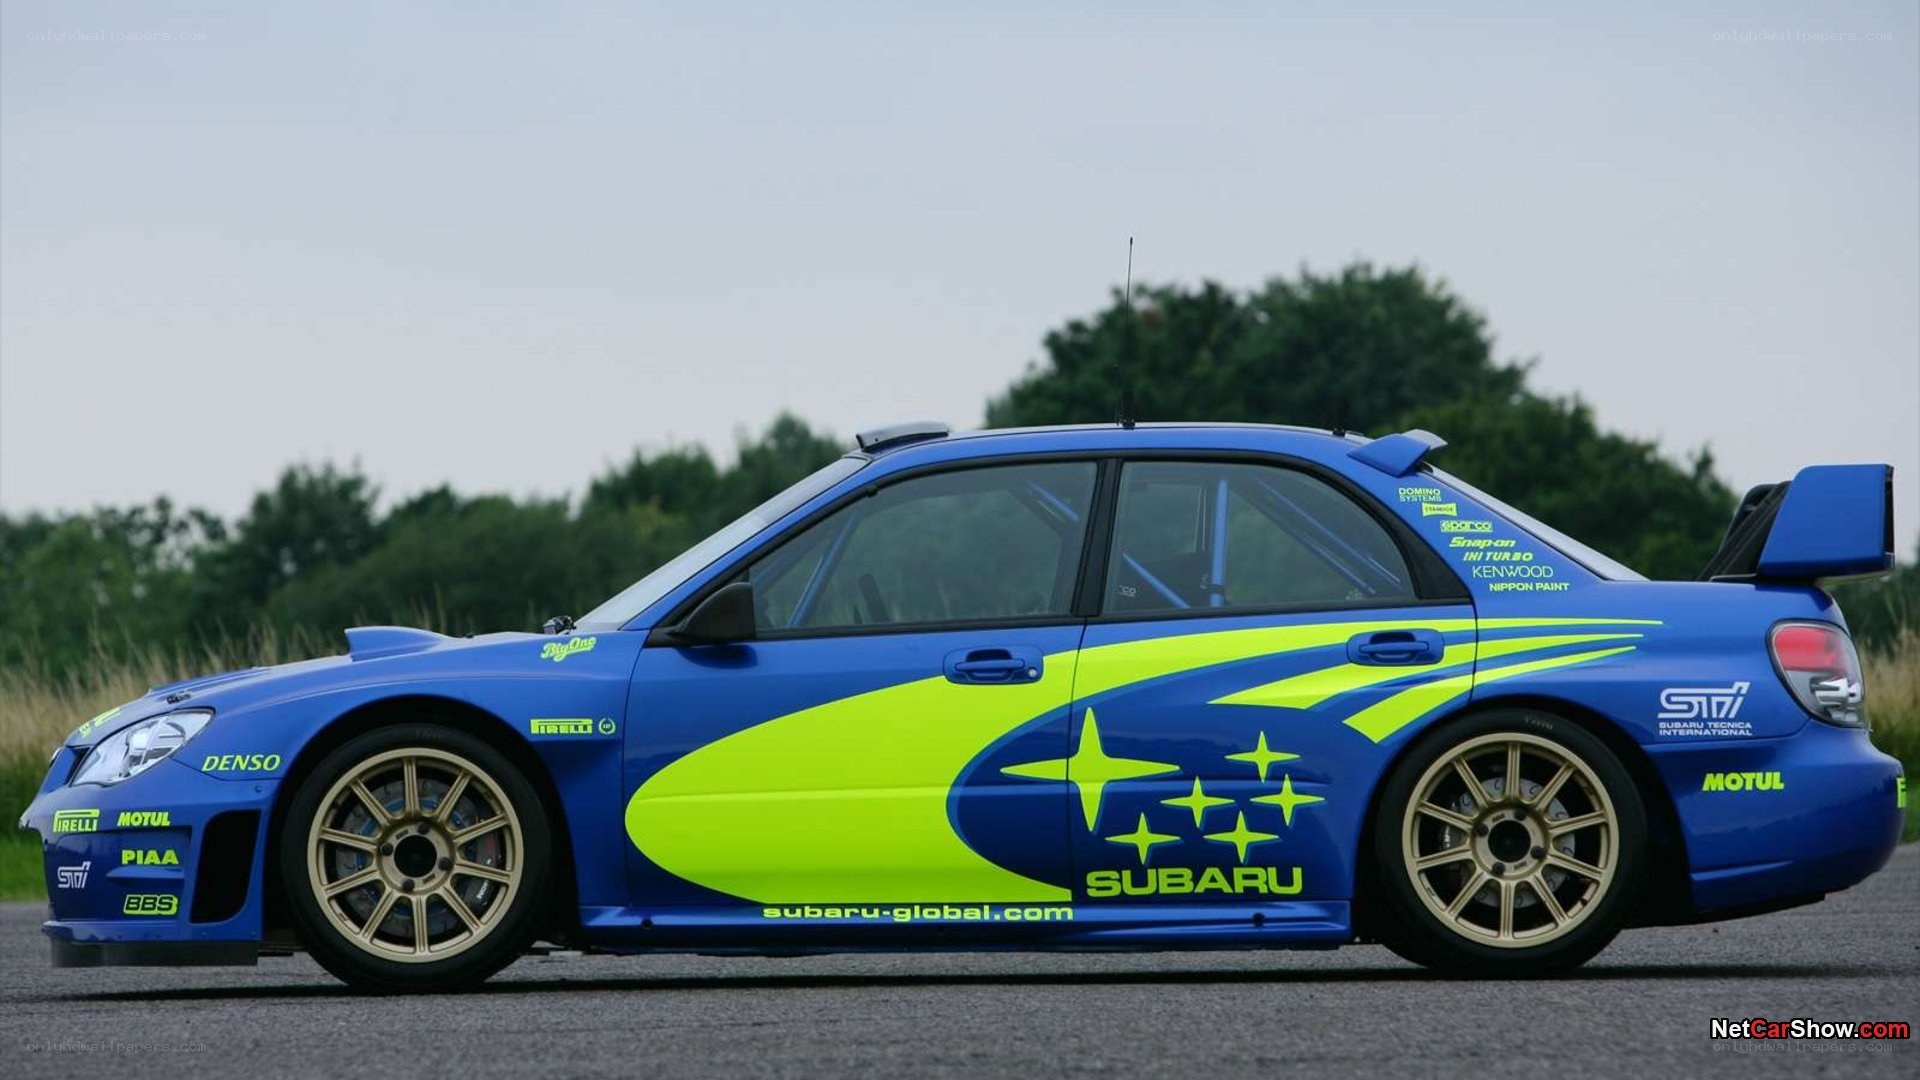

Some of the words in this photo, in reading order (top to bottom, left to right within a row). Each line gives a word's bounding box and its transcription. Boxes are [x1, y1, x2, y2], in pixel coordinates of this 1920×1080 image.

[1440, 520, 1493, 532] sparco
[1449, 536, 1516, 549] Snap-on
[1463, 551, 1483, 562] IHI
[1485, 551, 1534, 562] TURBO
[1472, 565, 1554, 578] KENWOOD
[1489, 582, 1533, 592] NIPPON
[1536, 582, 1570, 592] PAINT
[530, 718, 593, 735] PIRELLI
[1659, 721, 1704, 729] SUBARU
[1707, 721, 1752, 729] TECNICA
[202, 754, 281, 772] DENSO
[1702, 771, 1784, 791] MOTUL
[53, 809, 100, 832] PIRELLI
[117, 812, 171, 827] MOTUL
[121, 850, 179, 865] PIAA
[1086, 867, 1303, 896] SUBARU
[123, 894, 179, 915] BBS
[762, 904, 1074, 922] subaru-global.com
